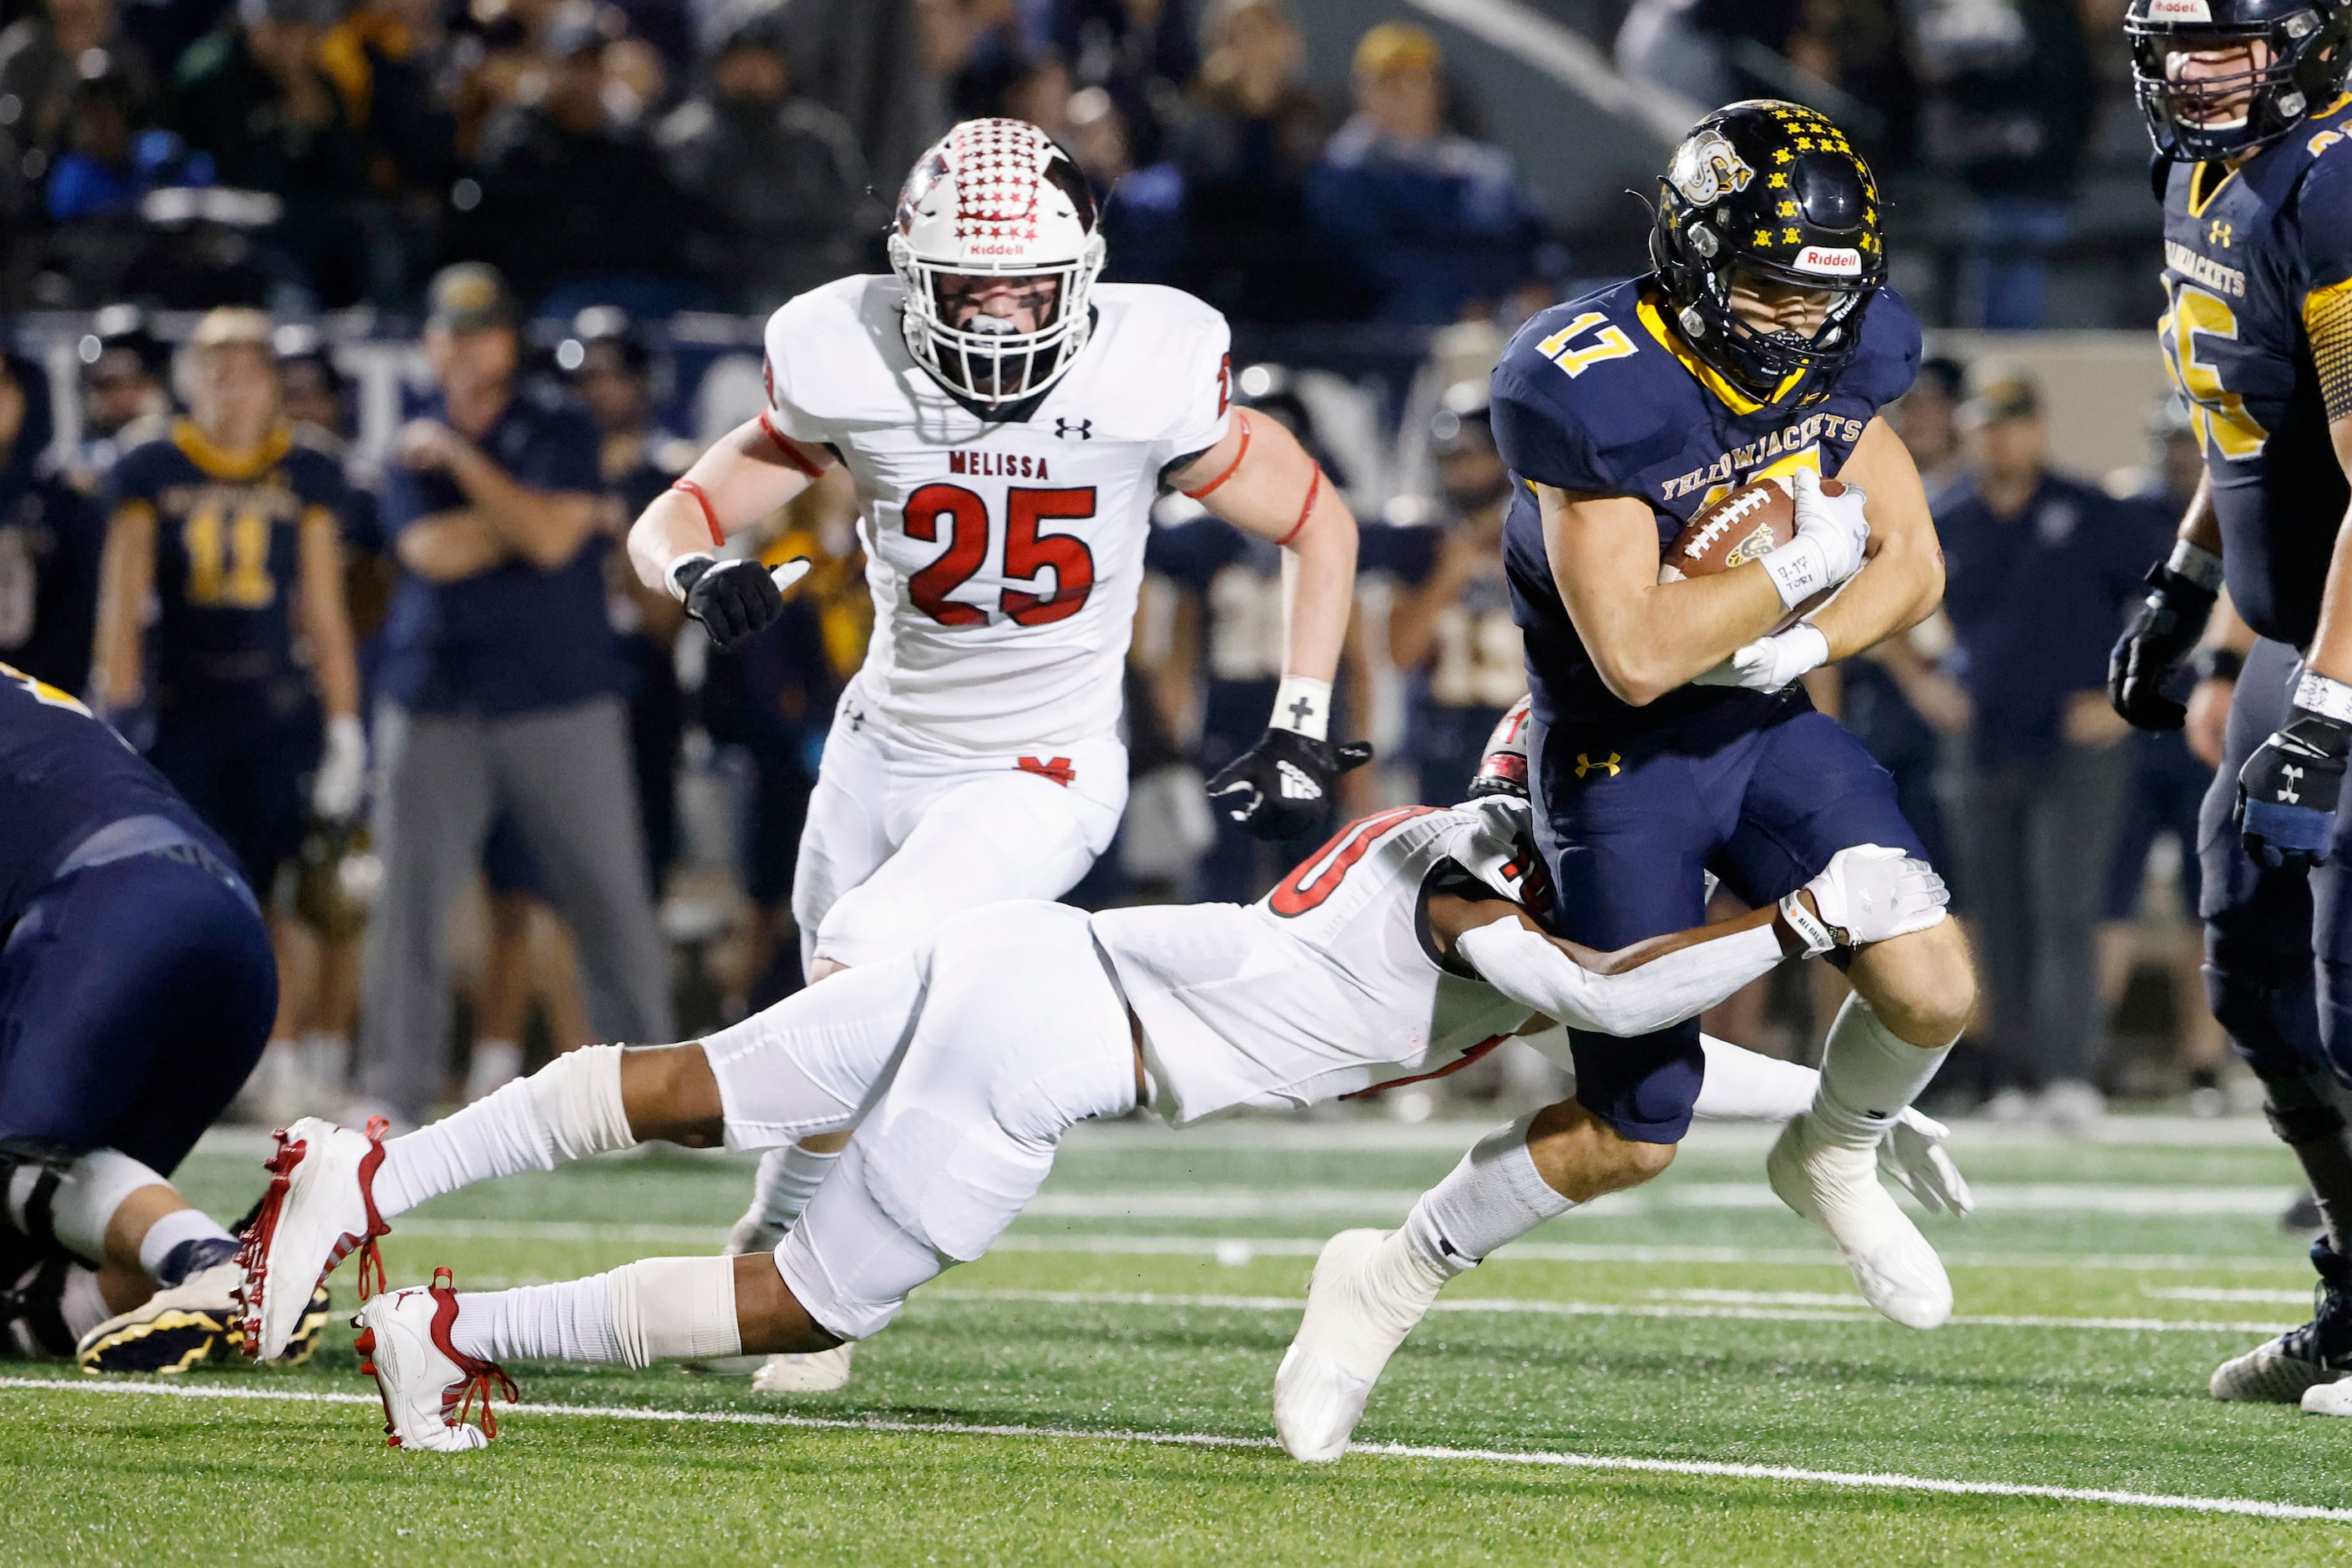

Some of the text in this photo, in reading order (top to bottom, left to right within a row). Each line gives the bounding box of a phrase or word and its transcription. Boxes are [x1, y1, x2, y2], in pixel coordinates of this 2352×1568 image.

[971, 245, 1024, 255] Riddell
[1808, 251, 1856, 266] Riddell
[1535, 311, 1639, 379] 17
[948, 450, 1049, 480] MELISSA
[1661, 412, 1864, 501] YELLOWJACKETS
[902, 483, 1097, 627] 25
[1786, 574, 1813, 590] TORI
[1268, 805, 1453, 918] 0
